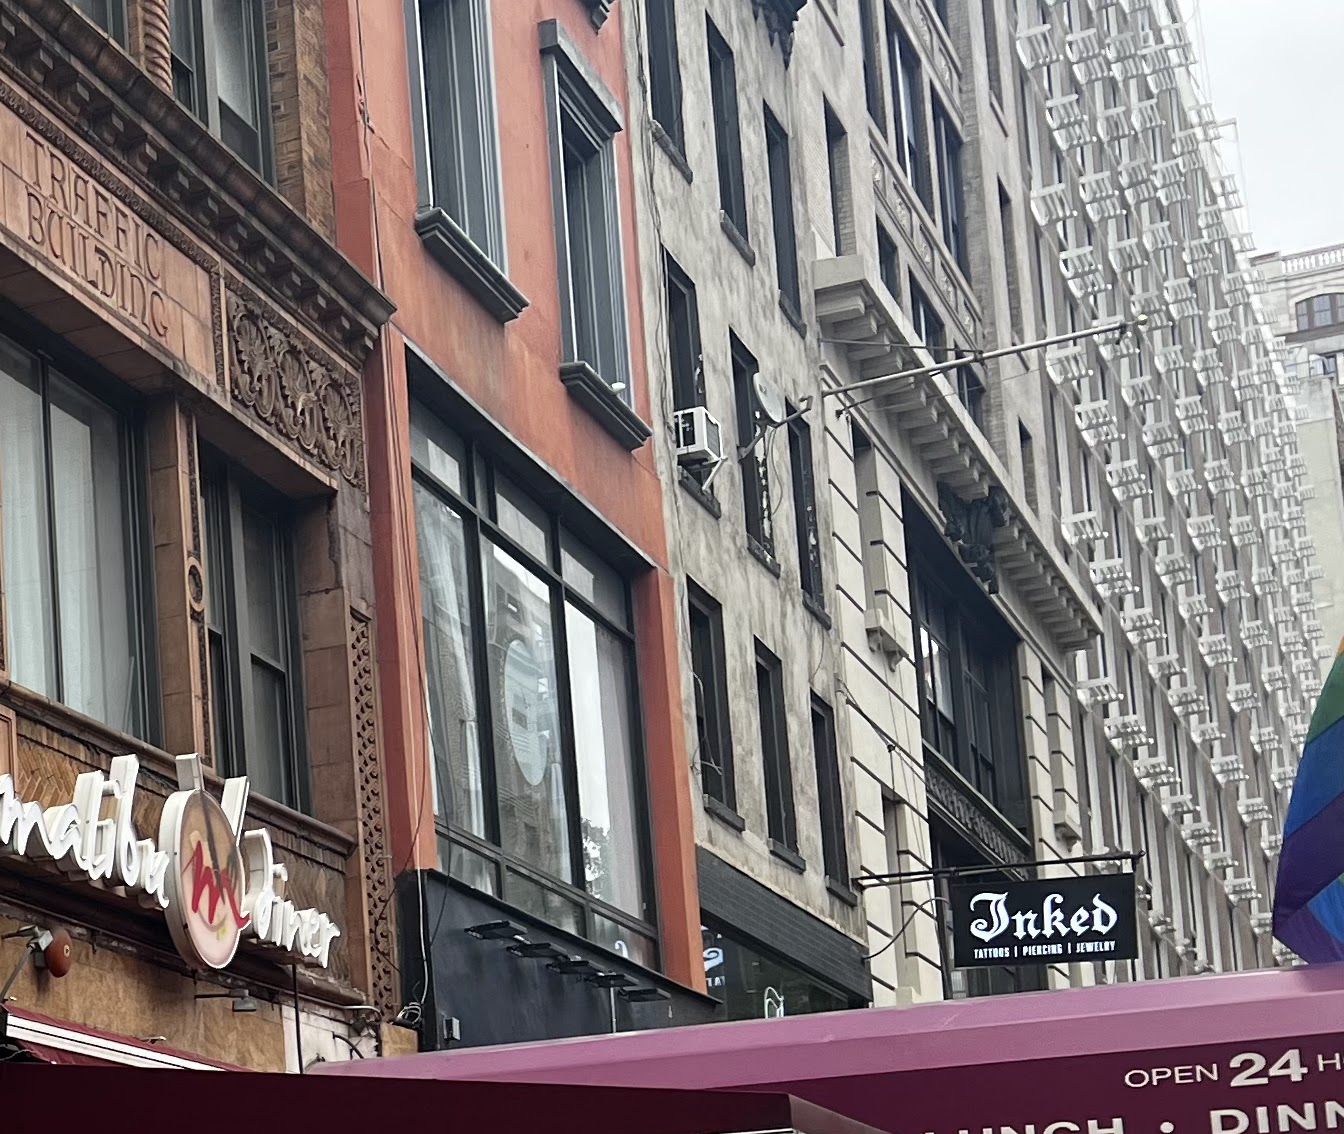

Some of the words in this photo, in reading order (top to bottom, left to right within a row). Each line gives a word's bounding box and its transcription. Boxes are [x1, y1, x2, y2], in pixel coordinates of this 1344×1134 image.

[26, 131, 161, 280] TRAFFIC
[969, 891, 1118, 943] Inked
[974, 947, 1010, 959] TATTOOS
[1022, 943, 1063, 957] PIERCING
[1075, 940, 1116, 953] JEWELRY
[1124, 1063, 1219, 1089] OPEN
[1229, 1048, 1308, 1087] 24
[1317, 1052, 1344, 1072] H
